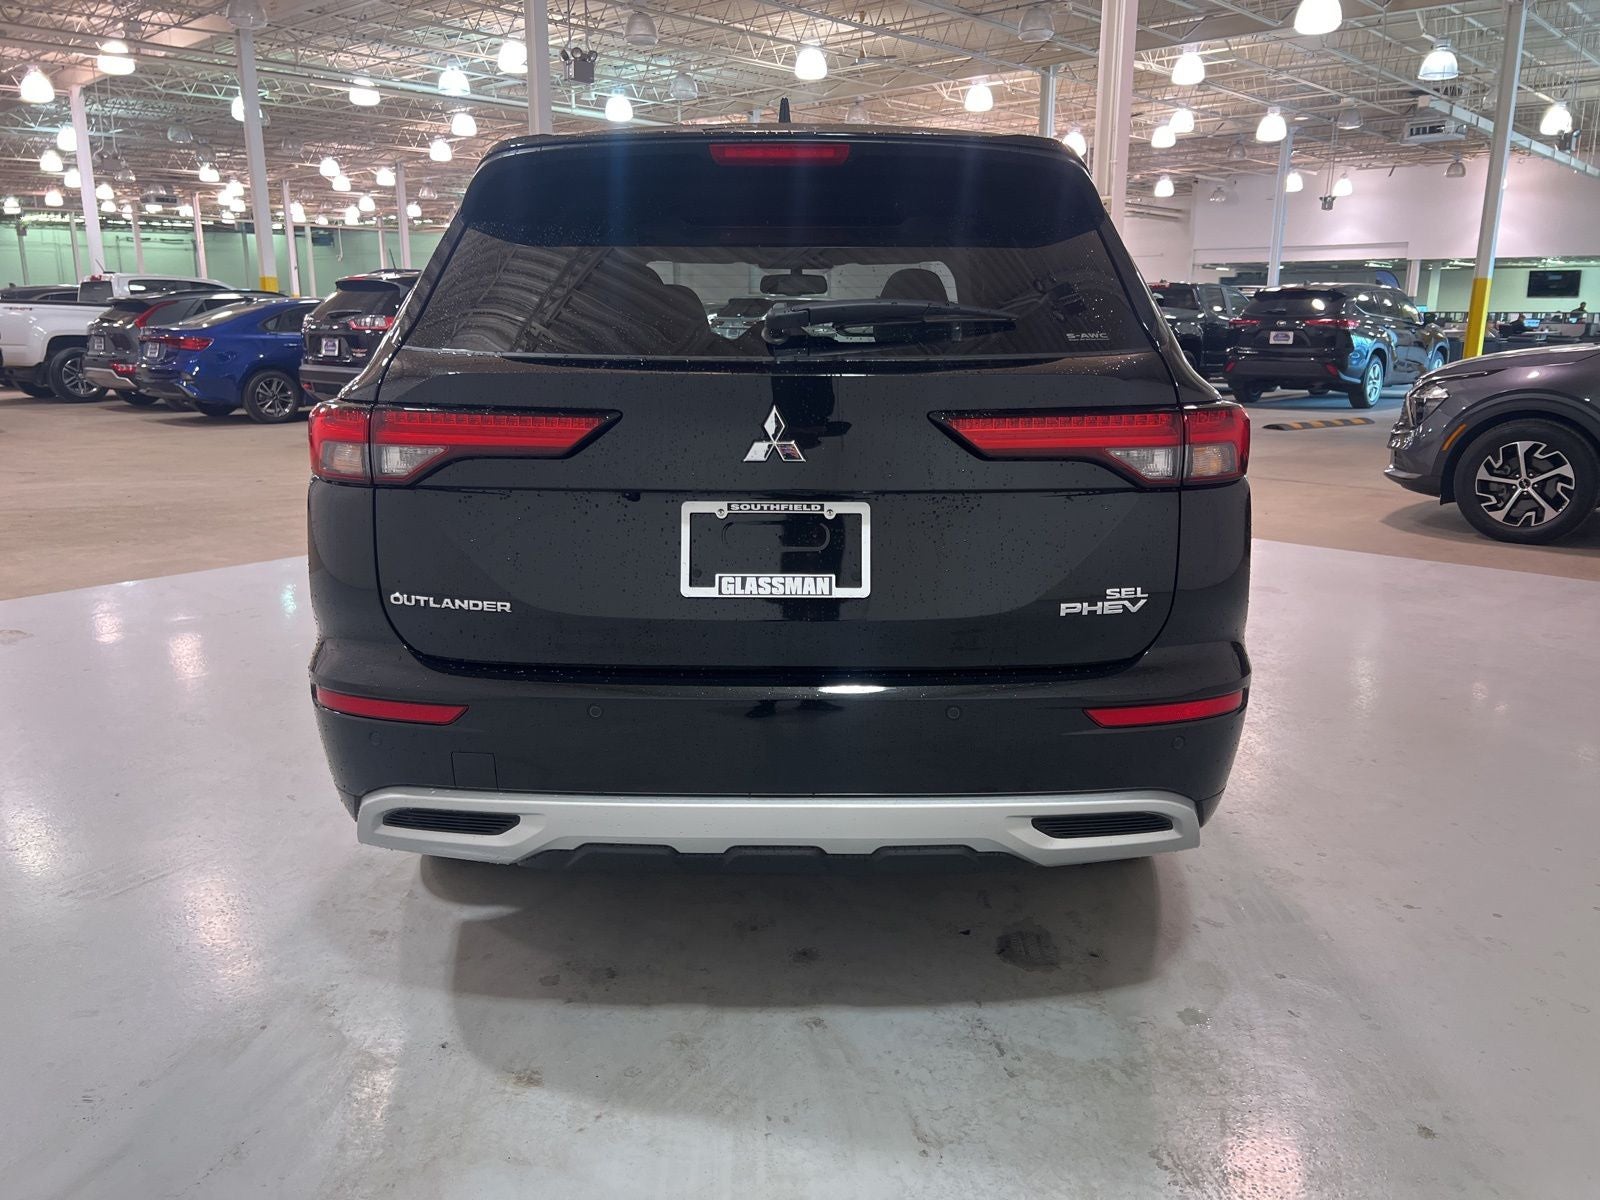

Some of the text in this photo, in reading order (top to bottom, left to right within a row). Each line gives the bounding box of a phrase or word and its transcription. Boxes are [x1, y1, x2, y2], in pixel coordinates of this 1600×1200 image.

[721, 576, 830, 595] GLASSMAN
[1106, 587, 1148, 599] SEL
[390, 592, 512, 612] OUTLANDER
[1060, 599, 1147, 616] PHEV
